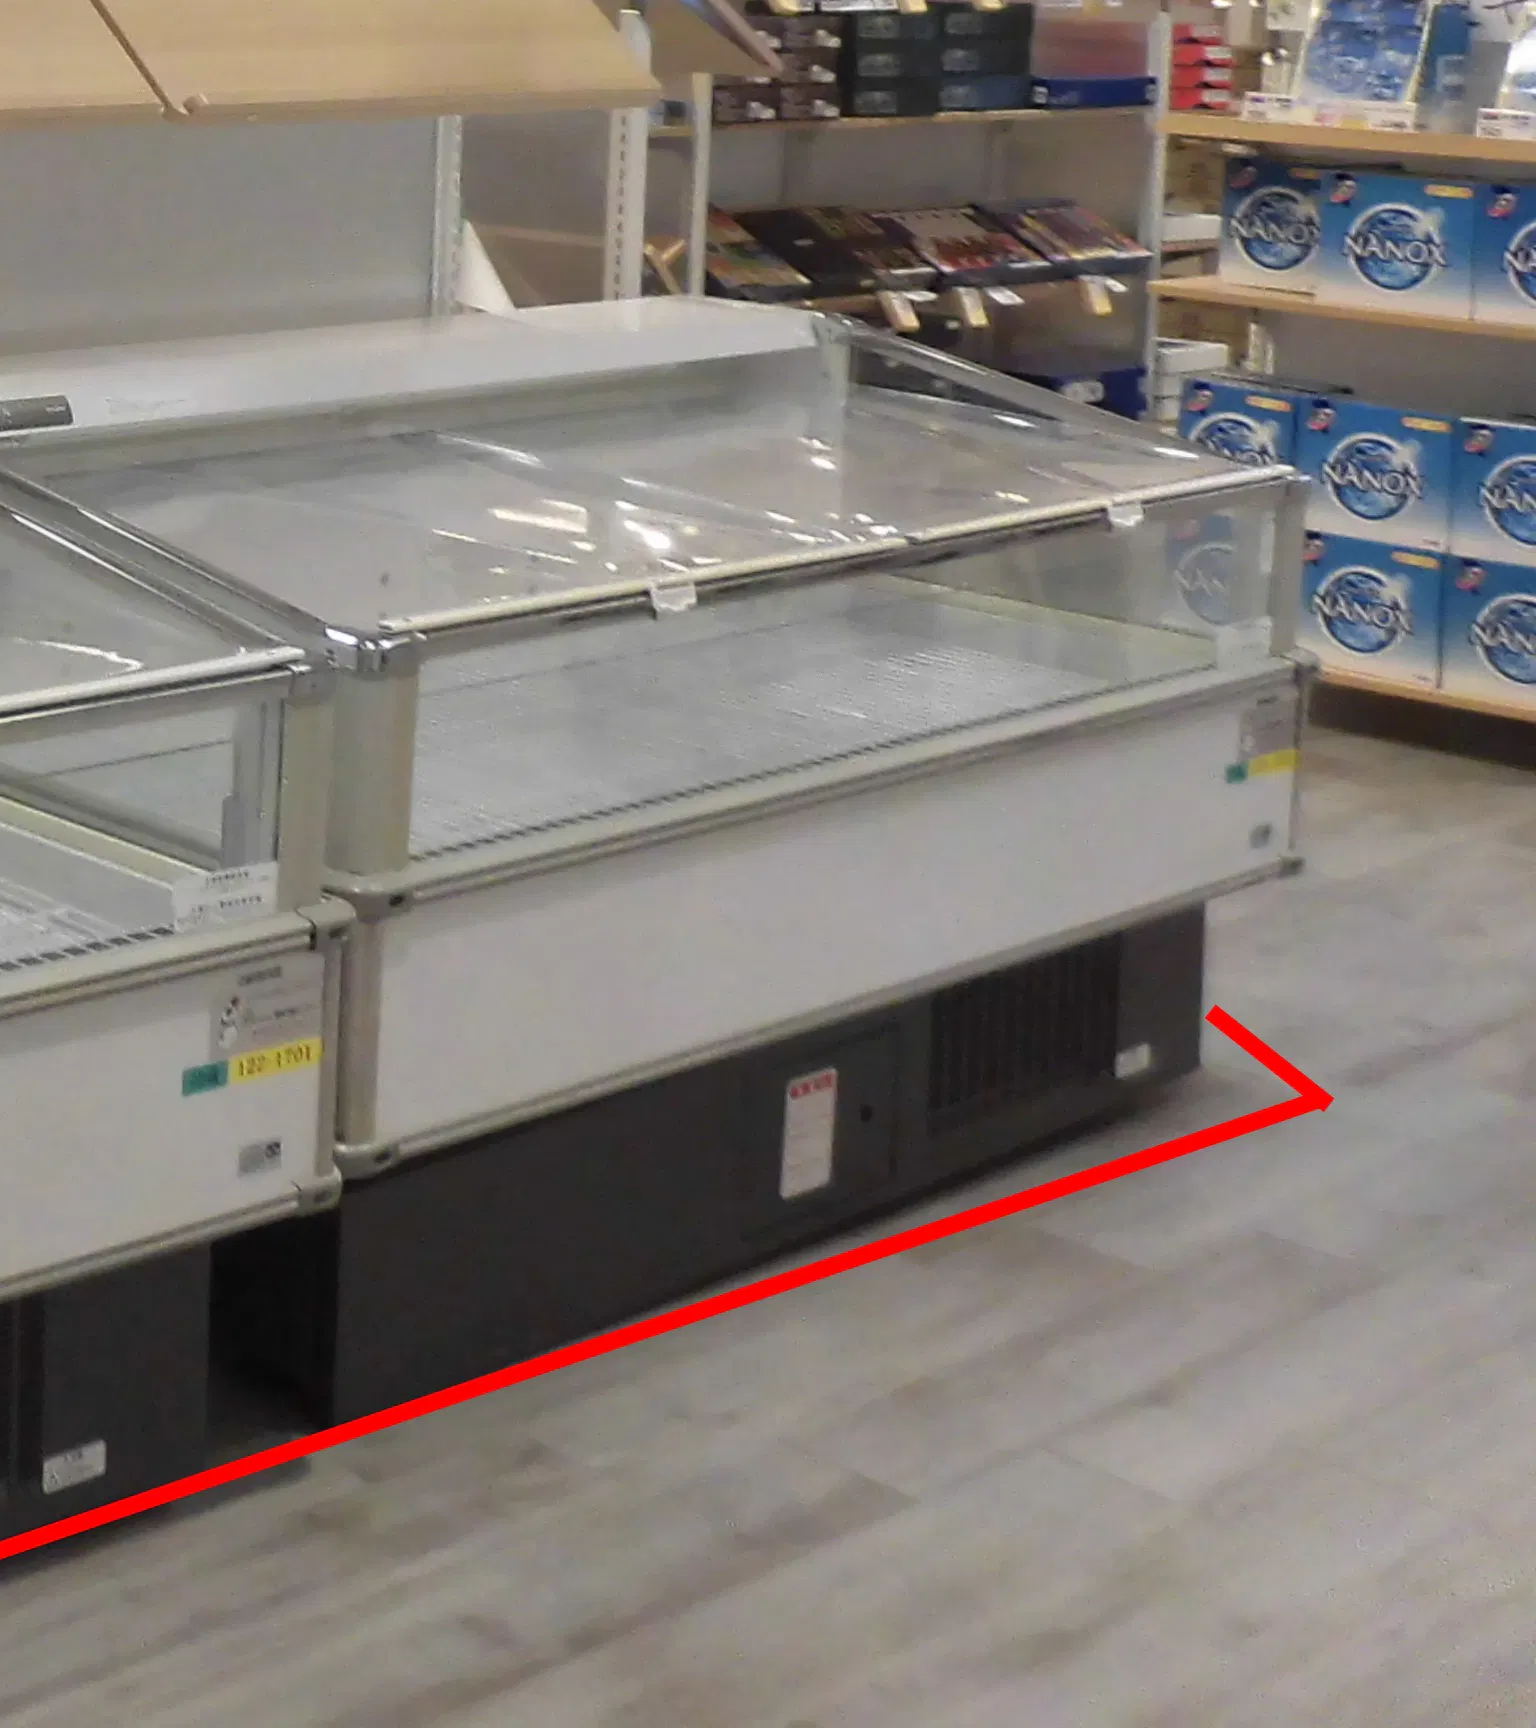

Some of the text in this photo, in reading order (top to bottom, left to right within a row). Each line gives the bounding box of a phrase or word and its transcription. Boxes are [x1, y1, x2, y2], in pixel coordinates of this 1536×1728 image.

[1344, 232, 1448, 267] NANOX
[1322, 460, 1424, 499] NANOX
[1313, 590, 1415, 636] NANOX
